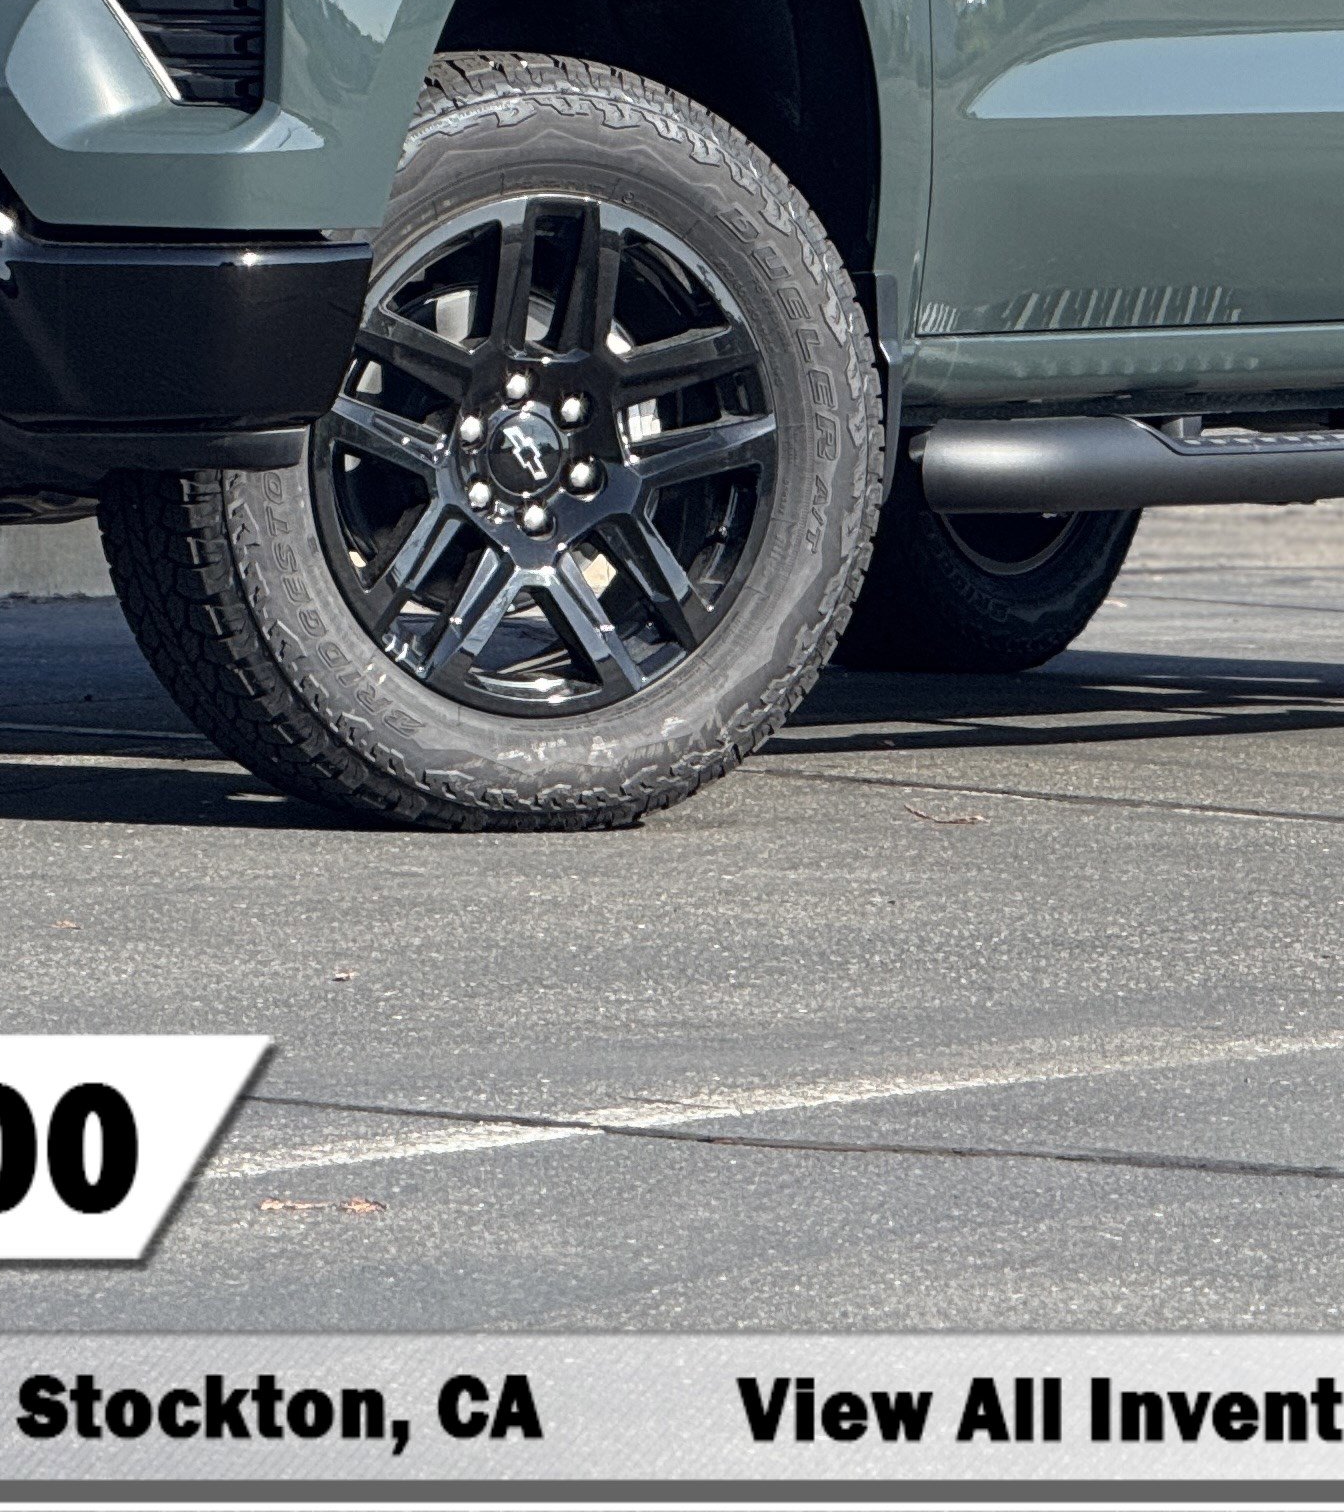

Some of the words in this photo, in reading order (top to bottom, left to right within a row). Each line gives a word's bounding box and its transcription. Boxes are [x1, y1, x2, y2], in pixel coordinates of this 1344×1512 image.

[713, 200, 841, 462] DUELER
[805, 475, 832, 556] A/T
[262, 469, 426, 738] BRIDGESTO
